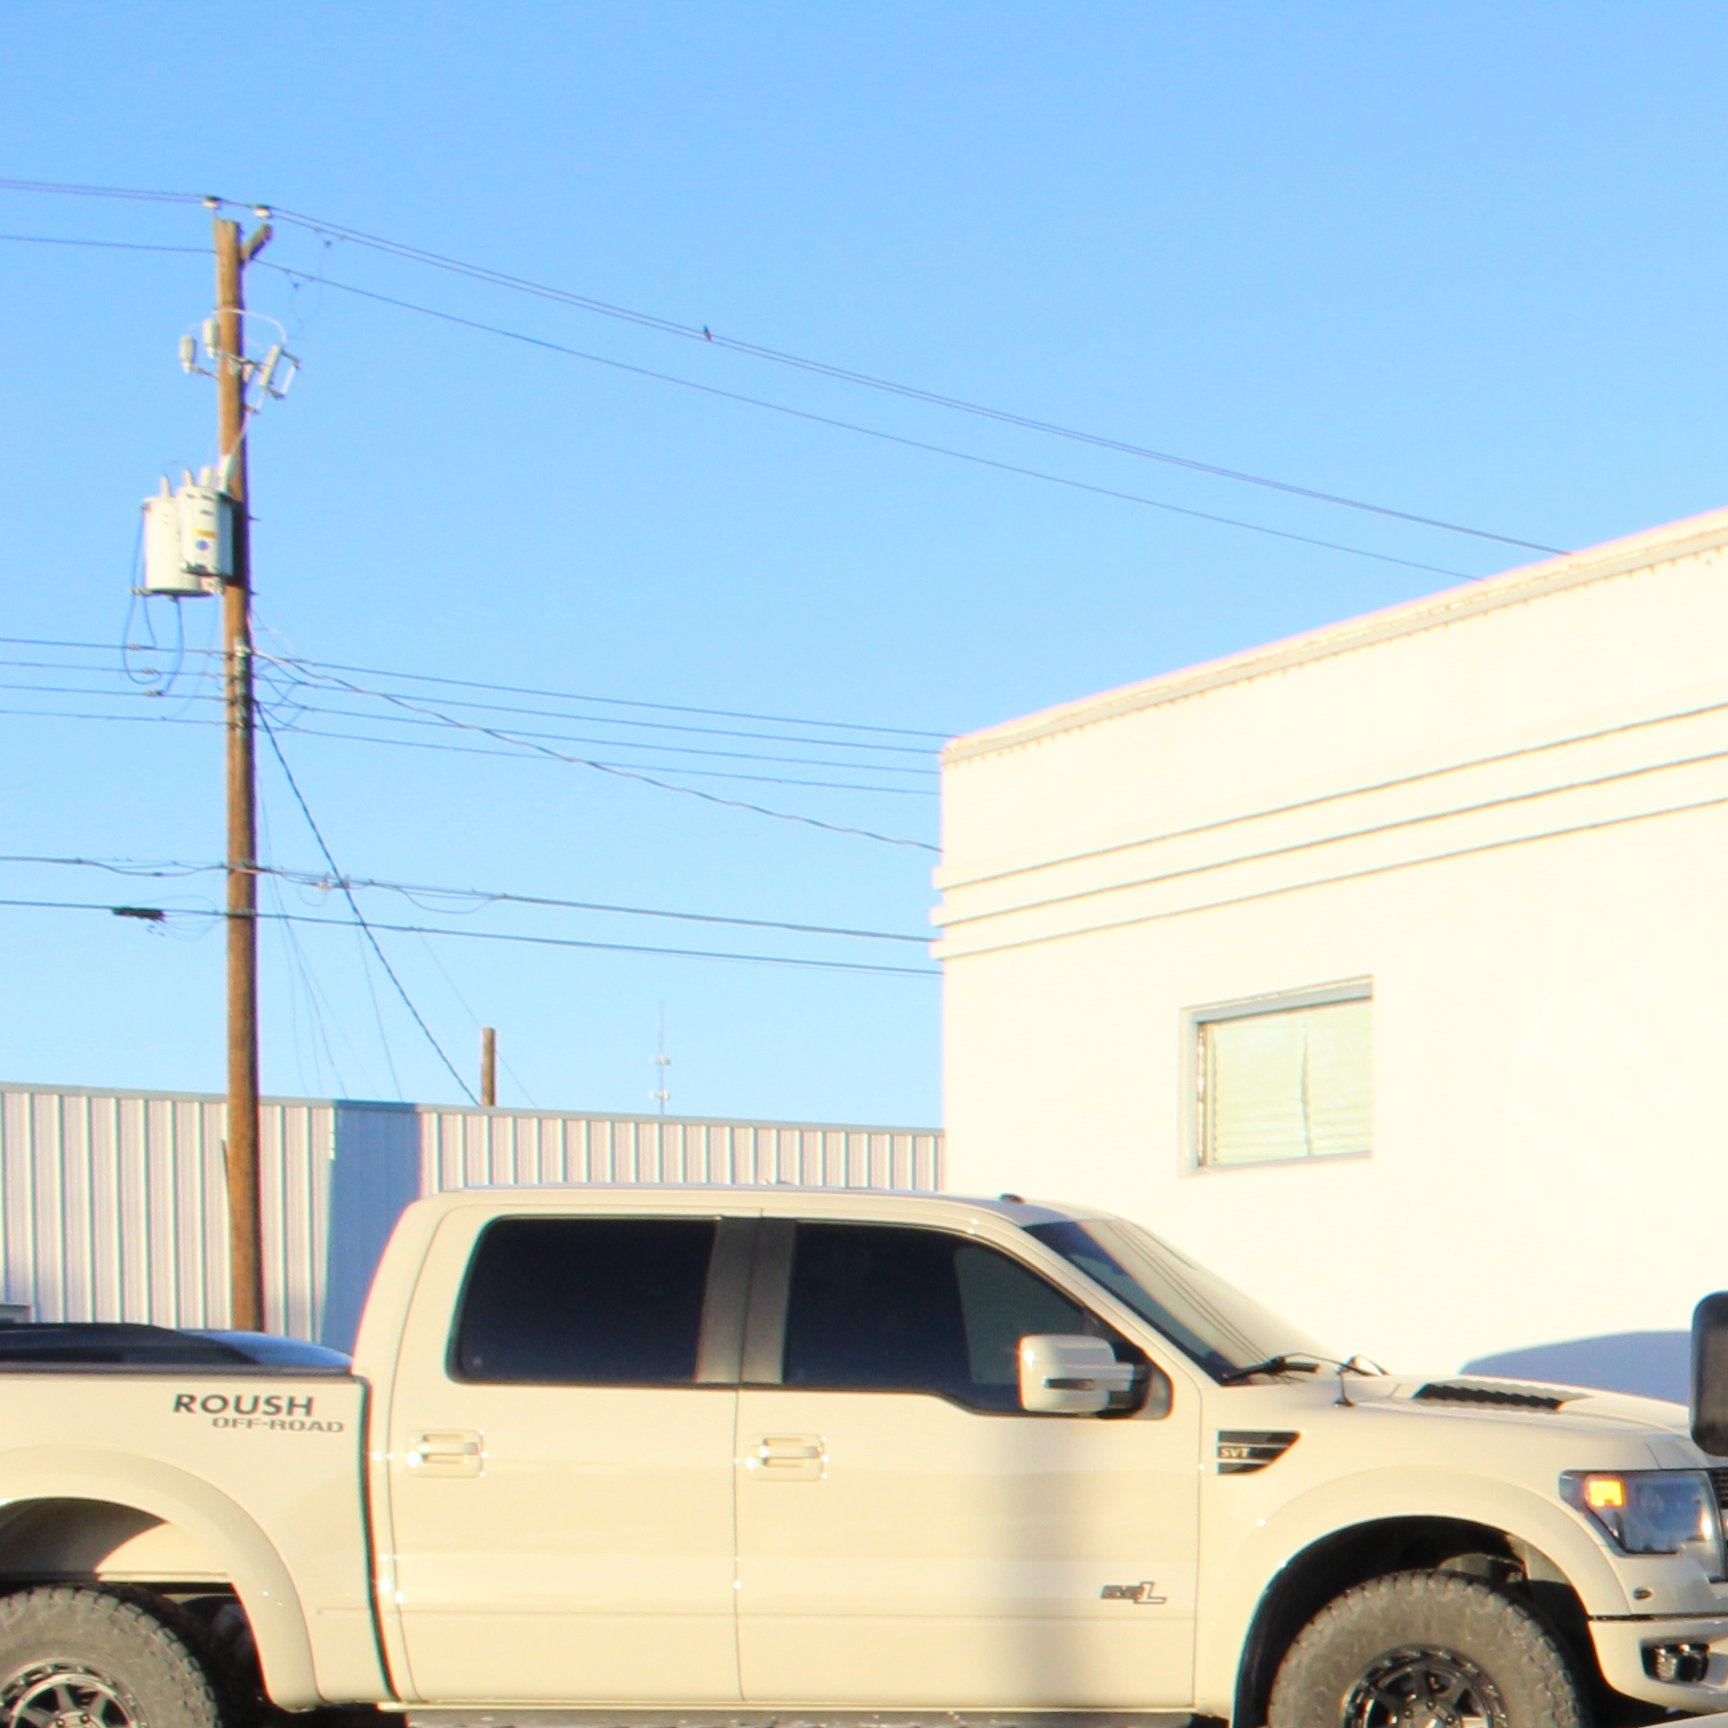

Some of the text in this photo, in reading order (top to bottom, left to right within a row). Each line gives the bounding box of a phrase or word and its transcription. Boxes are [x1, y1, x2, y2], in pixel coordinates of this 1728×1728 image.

[173, 1394, 315, 1416] ROUSH
[212, 1417, 345, 1433] OFF-ROAD
[1220, 1448, 1250, 1457] SVT
